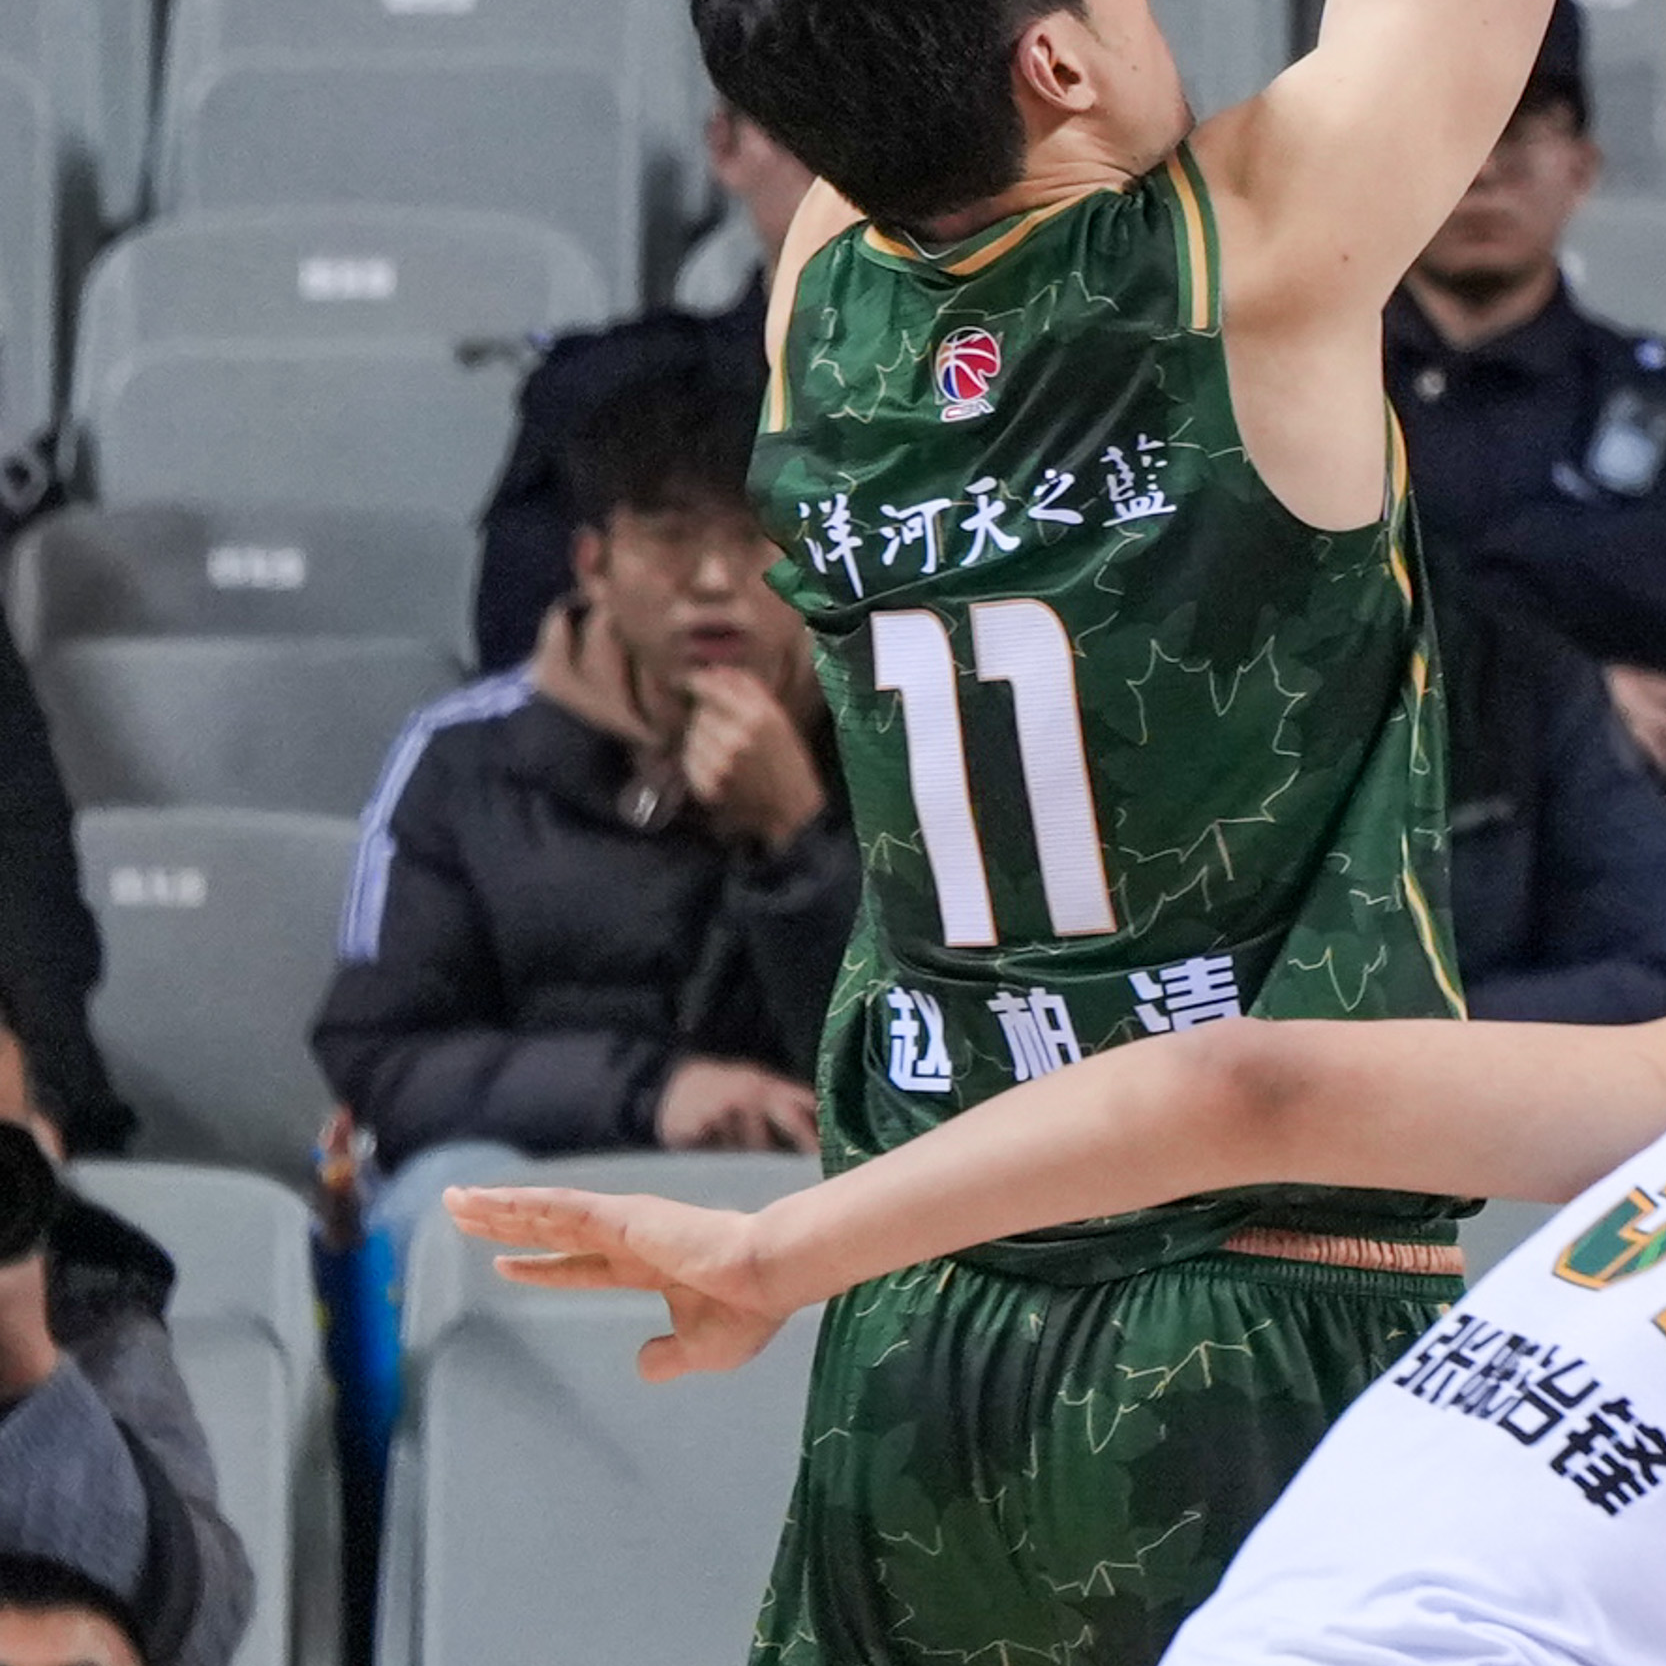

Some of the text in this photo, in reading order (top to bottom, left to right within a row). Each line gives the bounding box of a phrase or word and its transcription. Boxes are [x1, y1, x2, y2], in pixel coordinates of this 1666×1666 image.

[870, 598, 1118, 948] 11
[888, 954, 1242, 1093] 赵柏清
